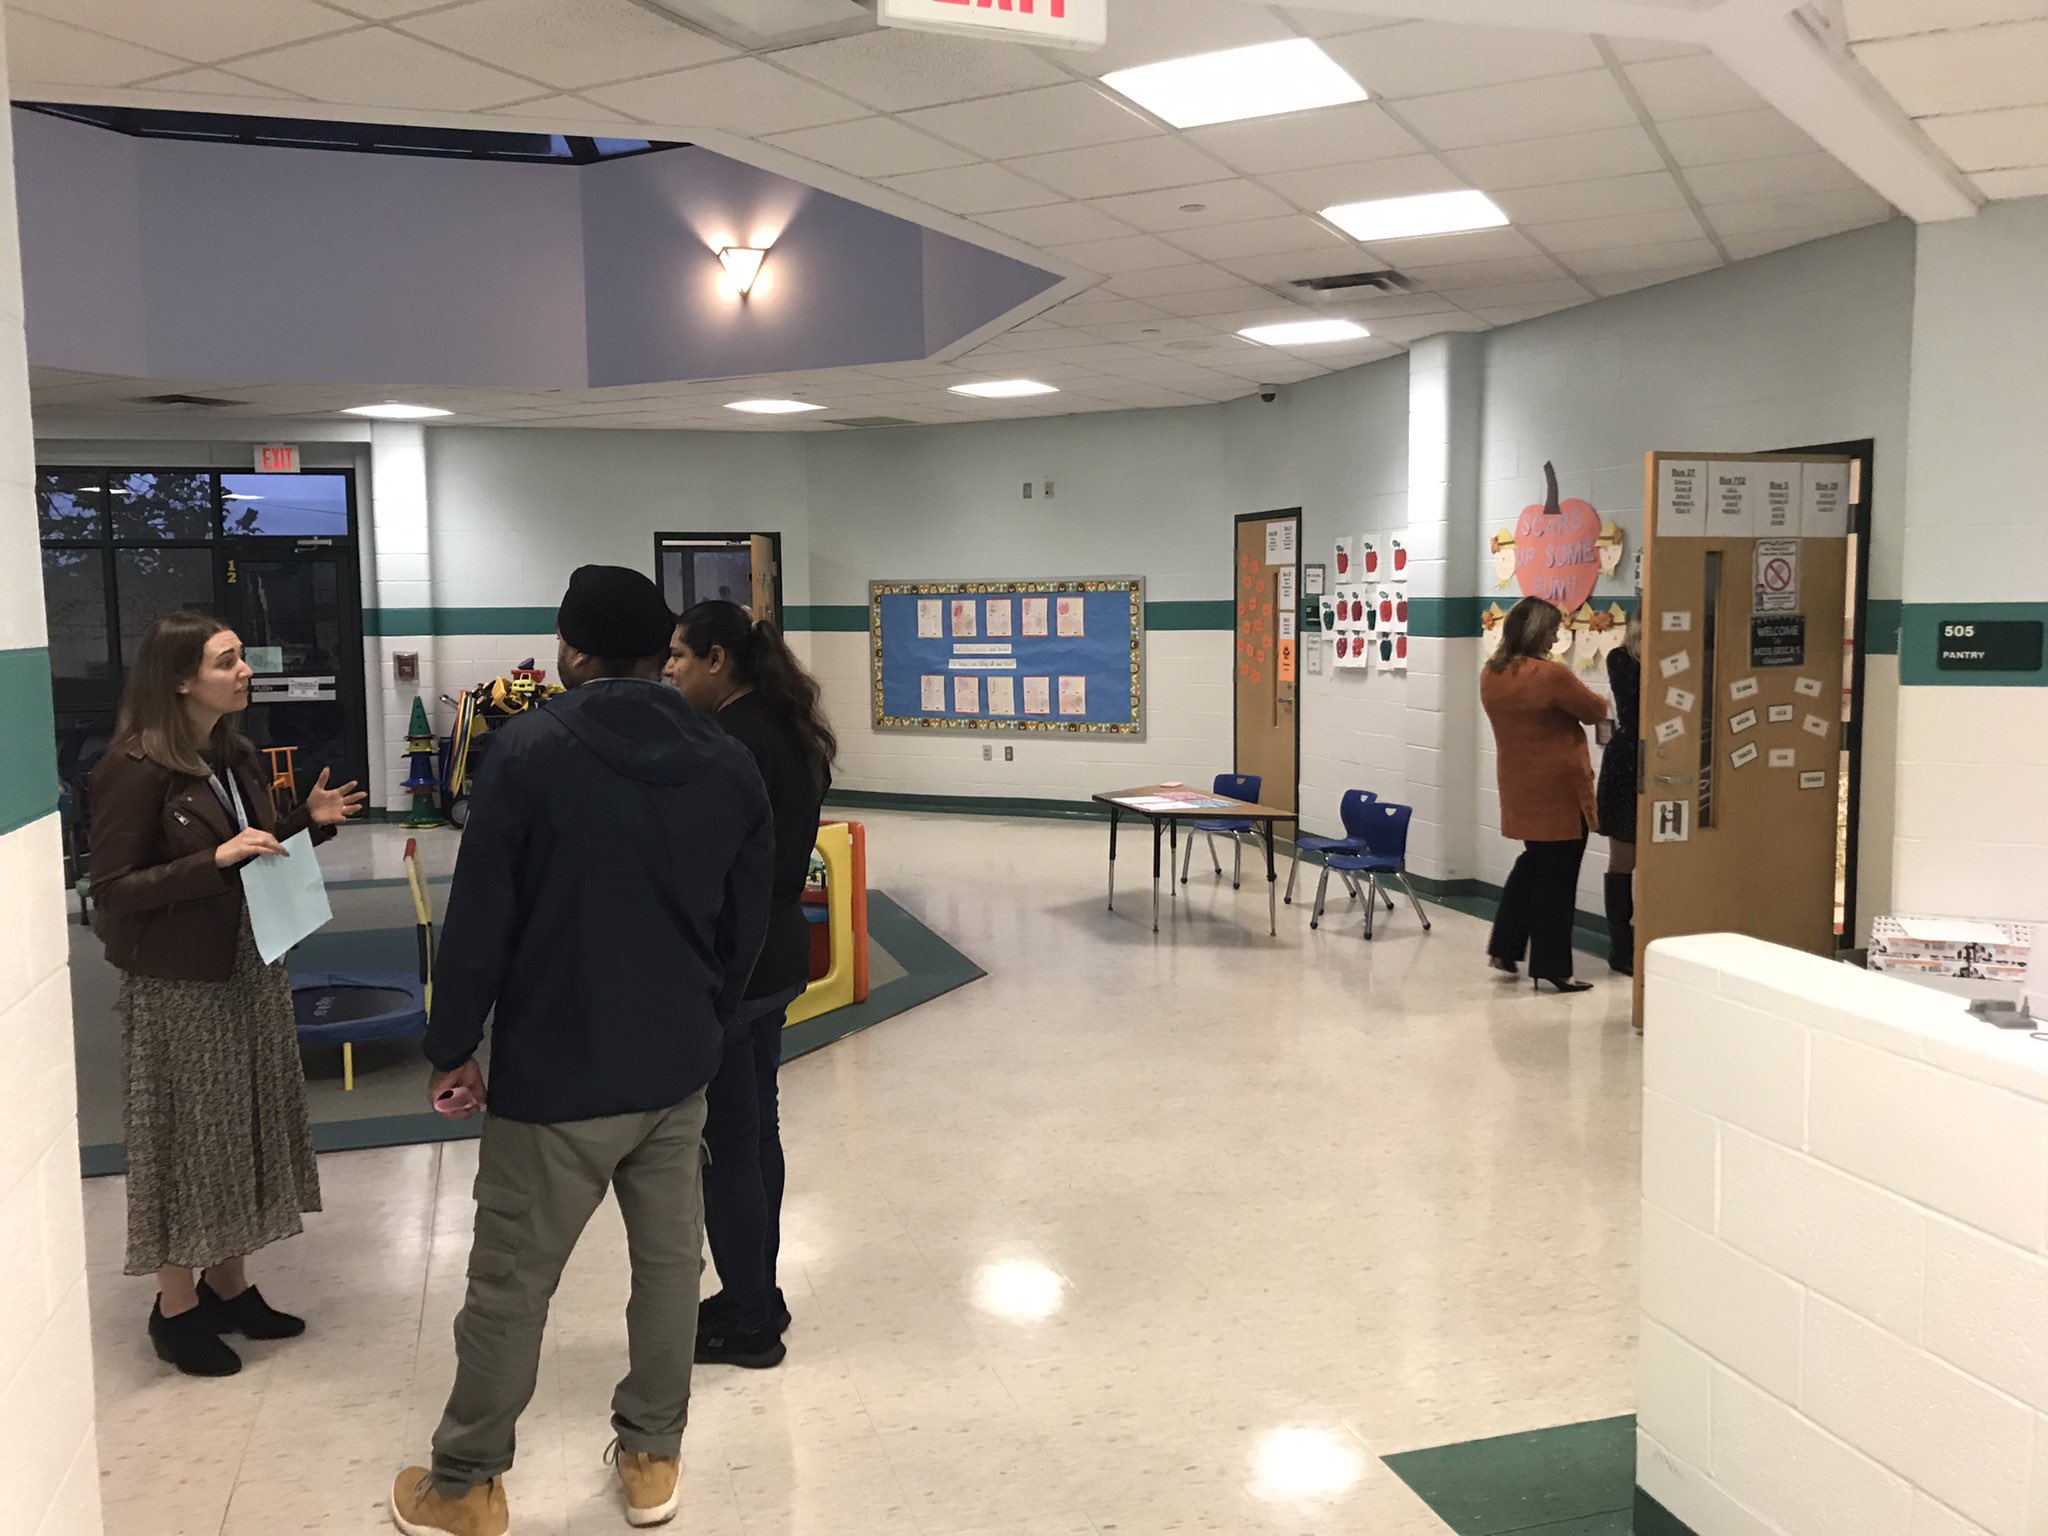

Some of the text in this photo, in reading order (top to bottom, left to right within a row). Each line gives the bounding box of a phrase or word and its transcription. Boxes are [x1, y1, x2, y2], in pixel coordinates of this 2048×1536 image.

[262, 447, 293, 470] EXIT
[1545, 540, 1596, 568] SOME
[1757, 625, 1799, 637] WELCOME
[1944, 625, 1974, 637] 505
[1942, 651, 1985, 659] PANTRY
